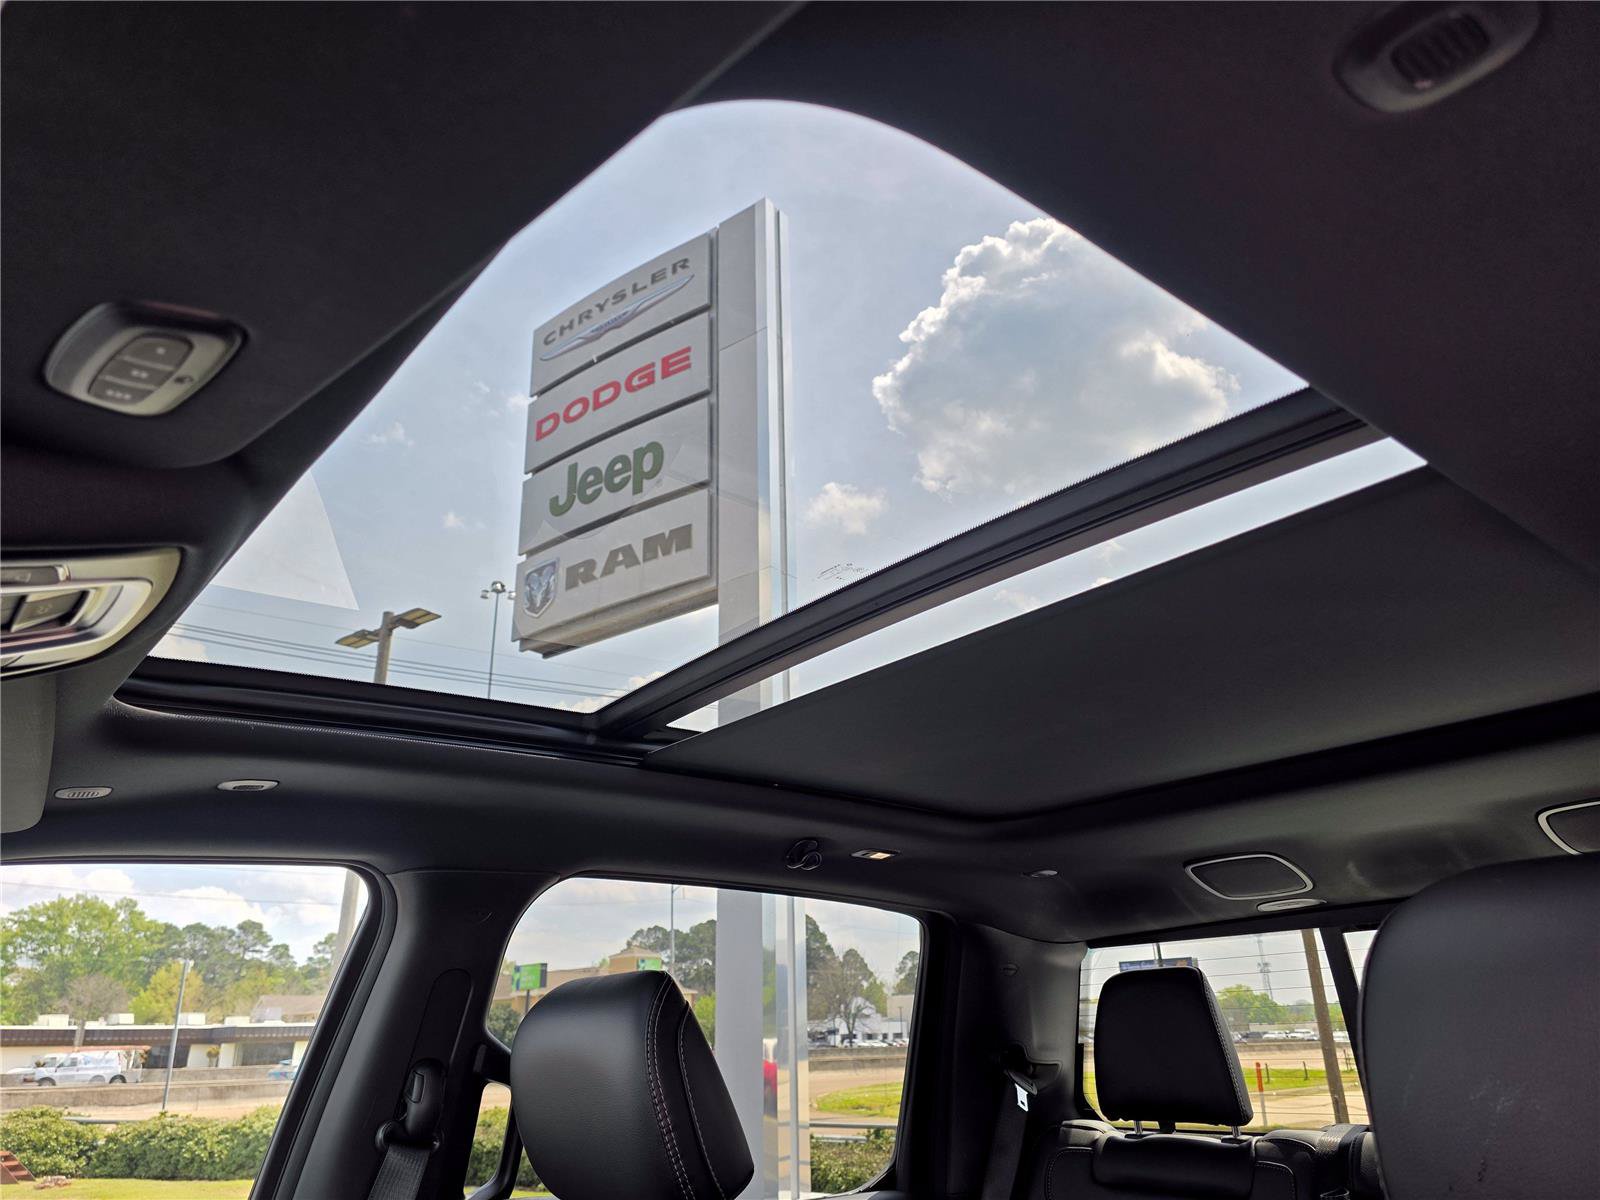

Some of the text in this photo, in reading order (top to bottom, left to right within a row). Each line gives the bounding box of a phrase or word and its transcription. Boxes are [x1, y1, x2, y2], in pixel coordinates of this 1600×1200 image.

[543, 257, 691, 346] CHRYSLER
[535, 346, 693, 442] DODGE
[549, 441, 664, 517] Jeep
[565, 523, 693, 591] RAM
